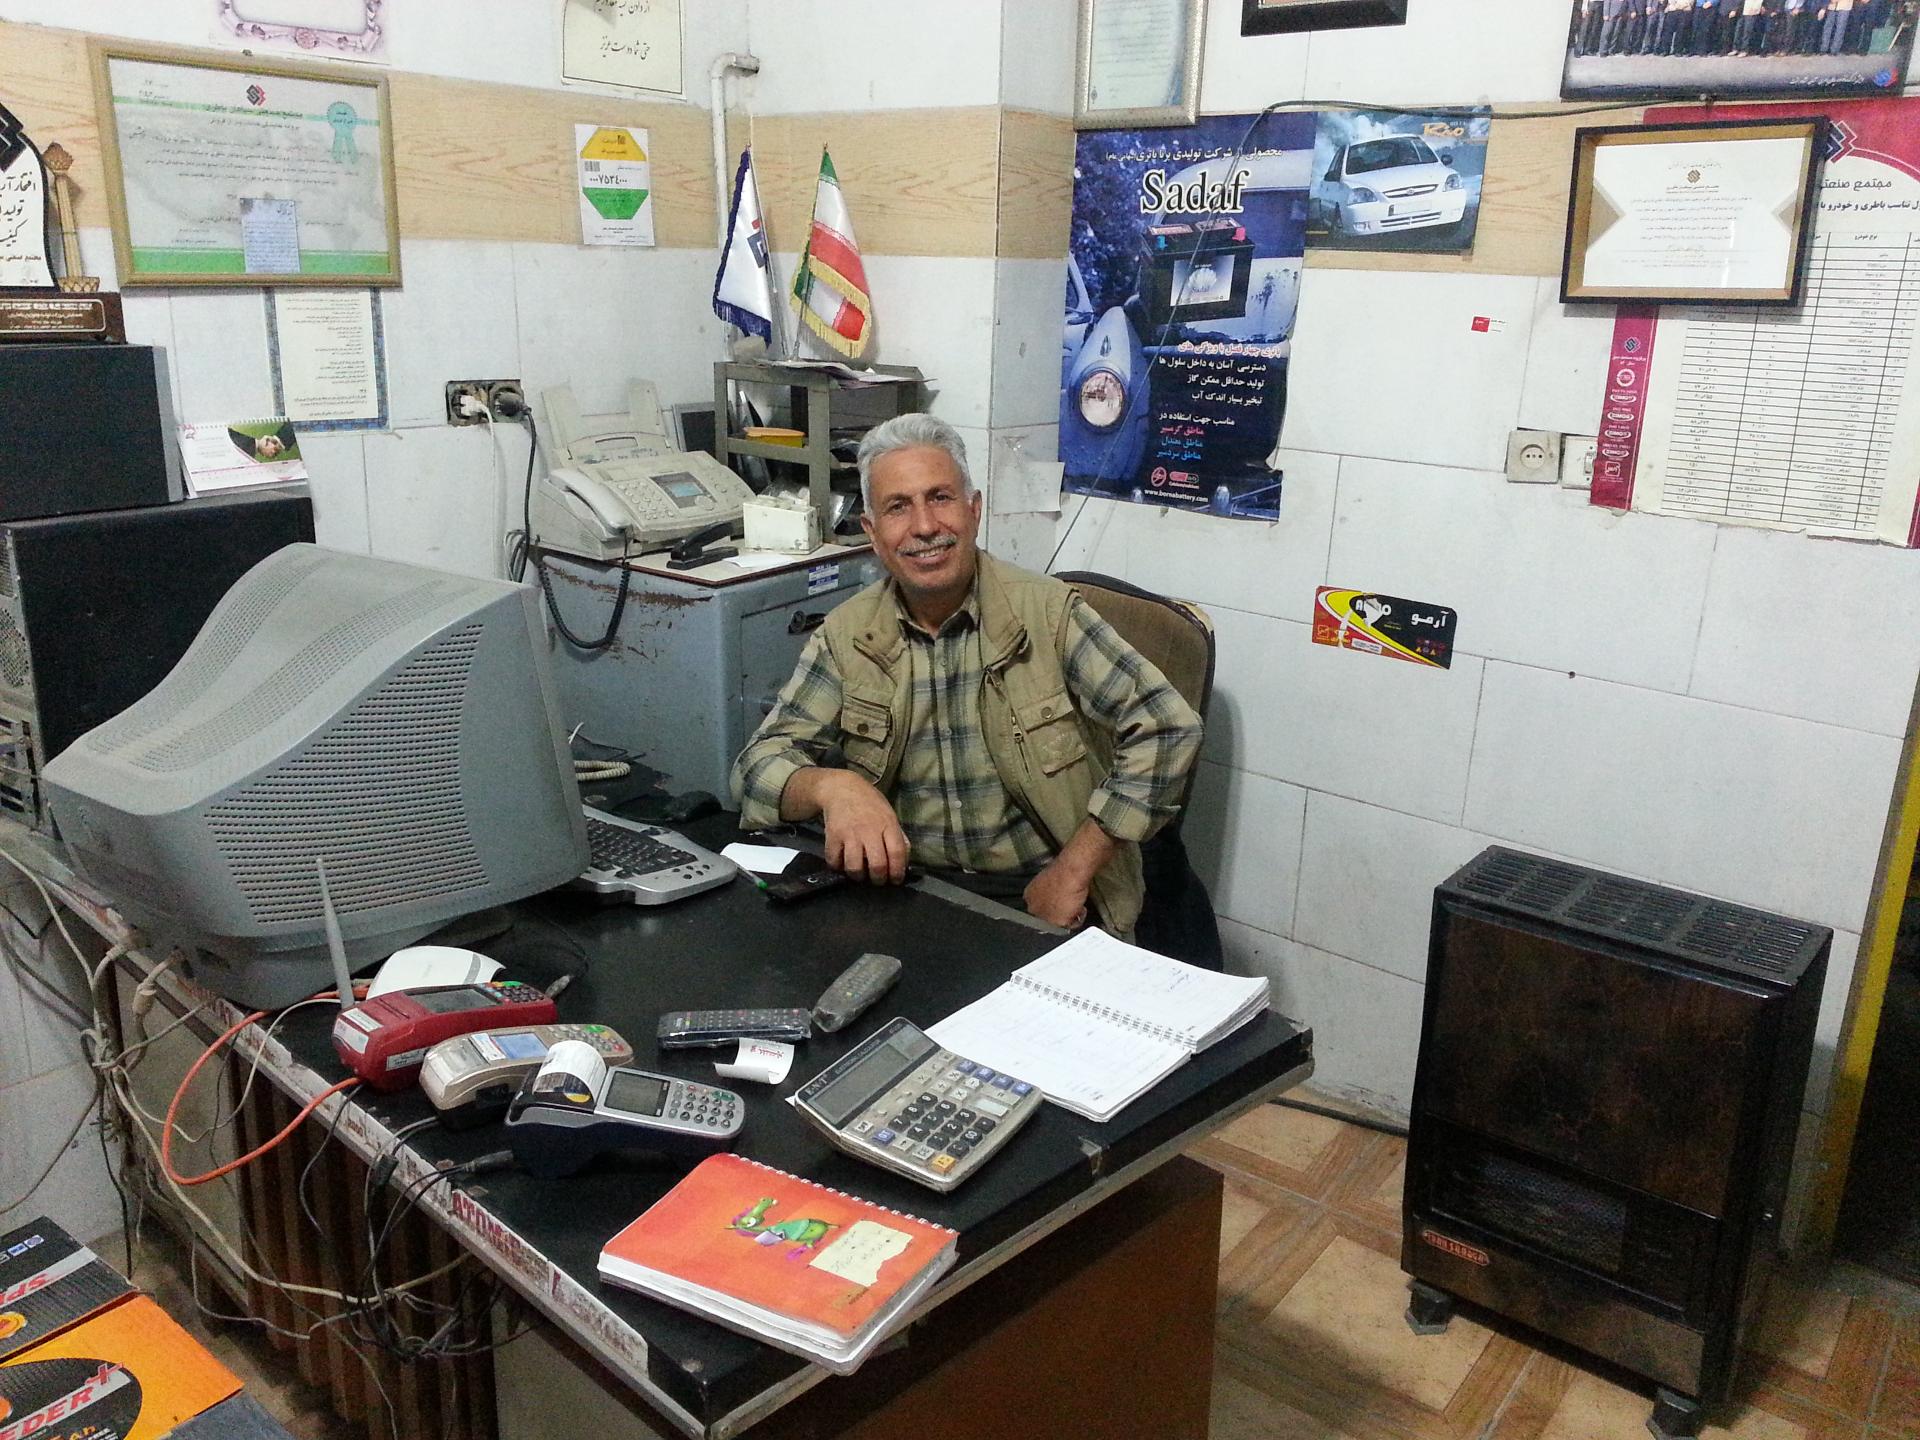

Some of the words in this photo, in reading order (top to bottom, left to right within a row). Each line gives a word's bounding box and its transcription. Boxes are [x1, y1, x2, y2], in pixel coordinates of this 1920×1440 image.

[1136, 149, 1158, 162] باتری
[1159, 149, 1171, 162] برنا
[1173, 148, 1201, 161] تولیدی
[1205, 148, 1232, 161] شرکت
[1245, 147, 1282, 161] محصولی
[1820, 178, 1850, 189] صنعت
[1853, 178, 1892, 192] مجتمع
[1141, 169, 1250, 214] Sadaf
[1827, 203, 1853, 211] خودرو
[1860, 200, 1886, 212] باطری
[1159, 356, 1166, 365] ها
[1167, 357, 1186, 368] سلول
[1187, 359, 1207, 369] داخل
[1216, 360, 1234, 370] آسان
[1237, 363, 1266, 373] دسترسی
[1187, 374, 1199, 384] گاز
[1200, 375, 1220, 385] ممکن
[1221, 377, 1245, 387] حداقل
[1247, 379, 1265, 390] تولید
[1192, 390, 1204, 400] آب
[1205, 392, 1226, 401] اندک
[1227, 394, 1243, 405] بسیار
[1244, 396, 1263, 406] تبخیر
[1159, 411, 1168, 421] در
[1169, 412, 1192, 421] استفاده
[1193, 415, 1211, 425] جهت
[1213, 416, 1235, 426] مناسب
[1144, 488, 1209, 502] www.bornabattery.com
[1411, 610, 1449, 629] آرمو
